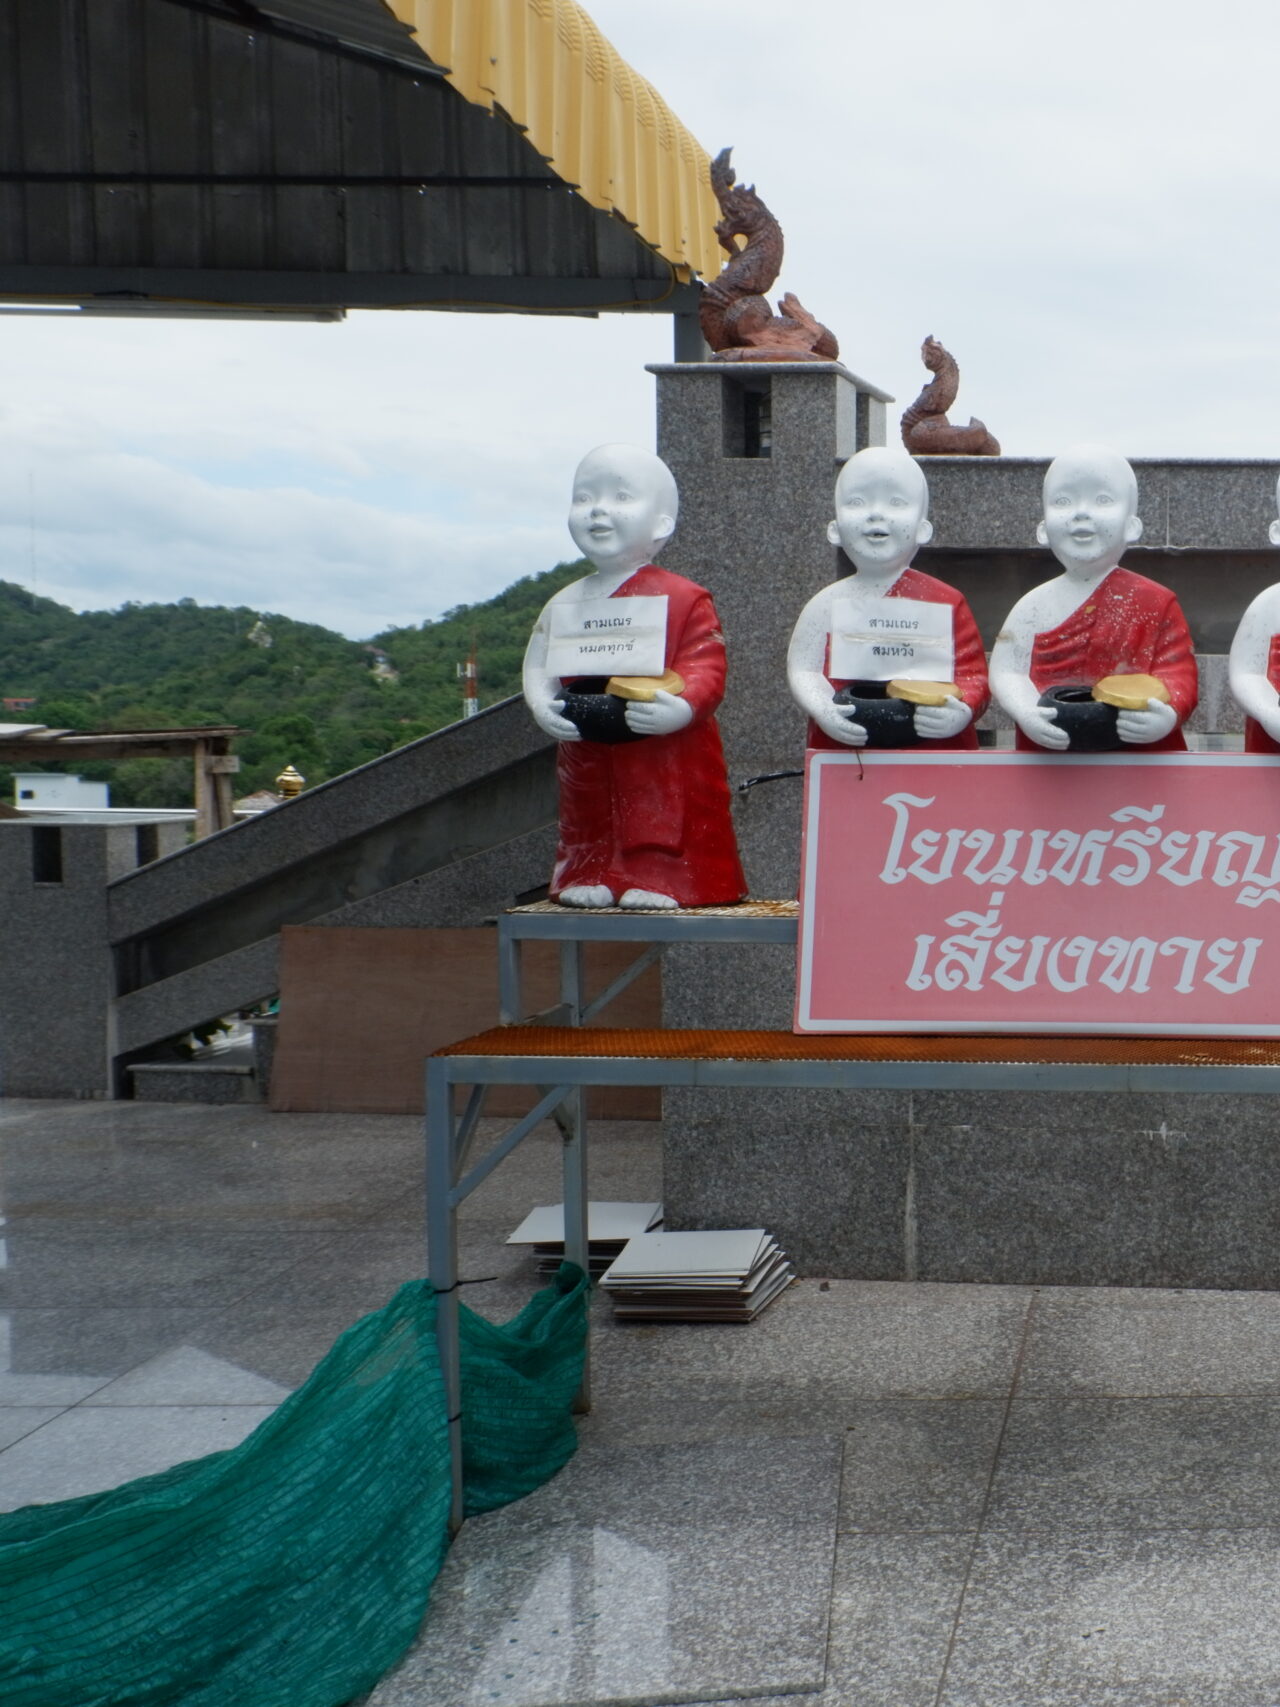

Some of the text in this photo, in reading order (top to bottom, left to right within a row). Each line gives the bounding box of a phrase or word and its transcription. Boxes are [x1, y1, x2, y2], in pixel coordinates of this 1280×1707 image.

[583, 616, 633, 630] สามเณร
[868, 617, 920, 630] สามเณร
[579, 638, 636, 656] หมดทุกข์
[872, 642, 915, 658] สมหวัง
[904, 891, 1263, 994] เสี่ยงทาย
